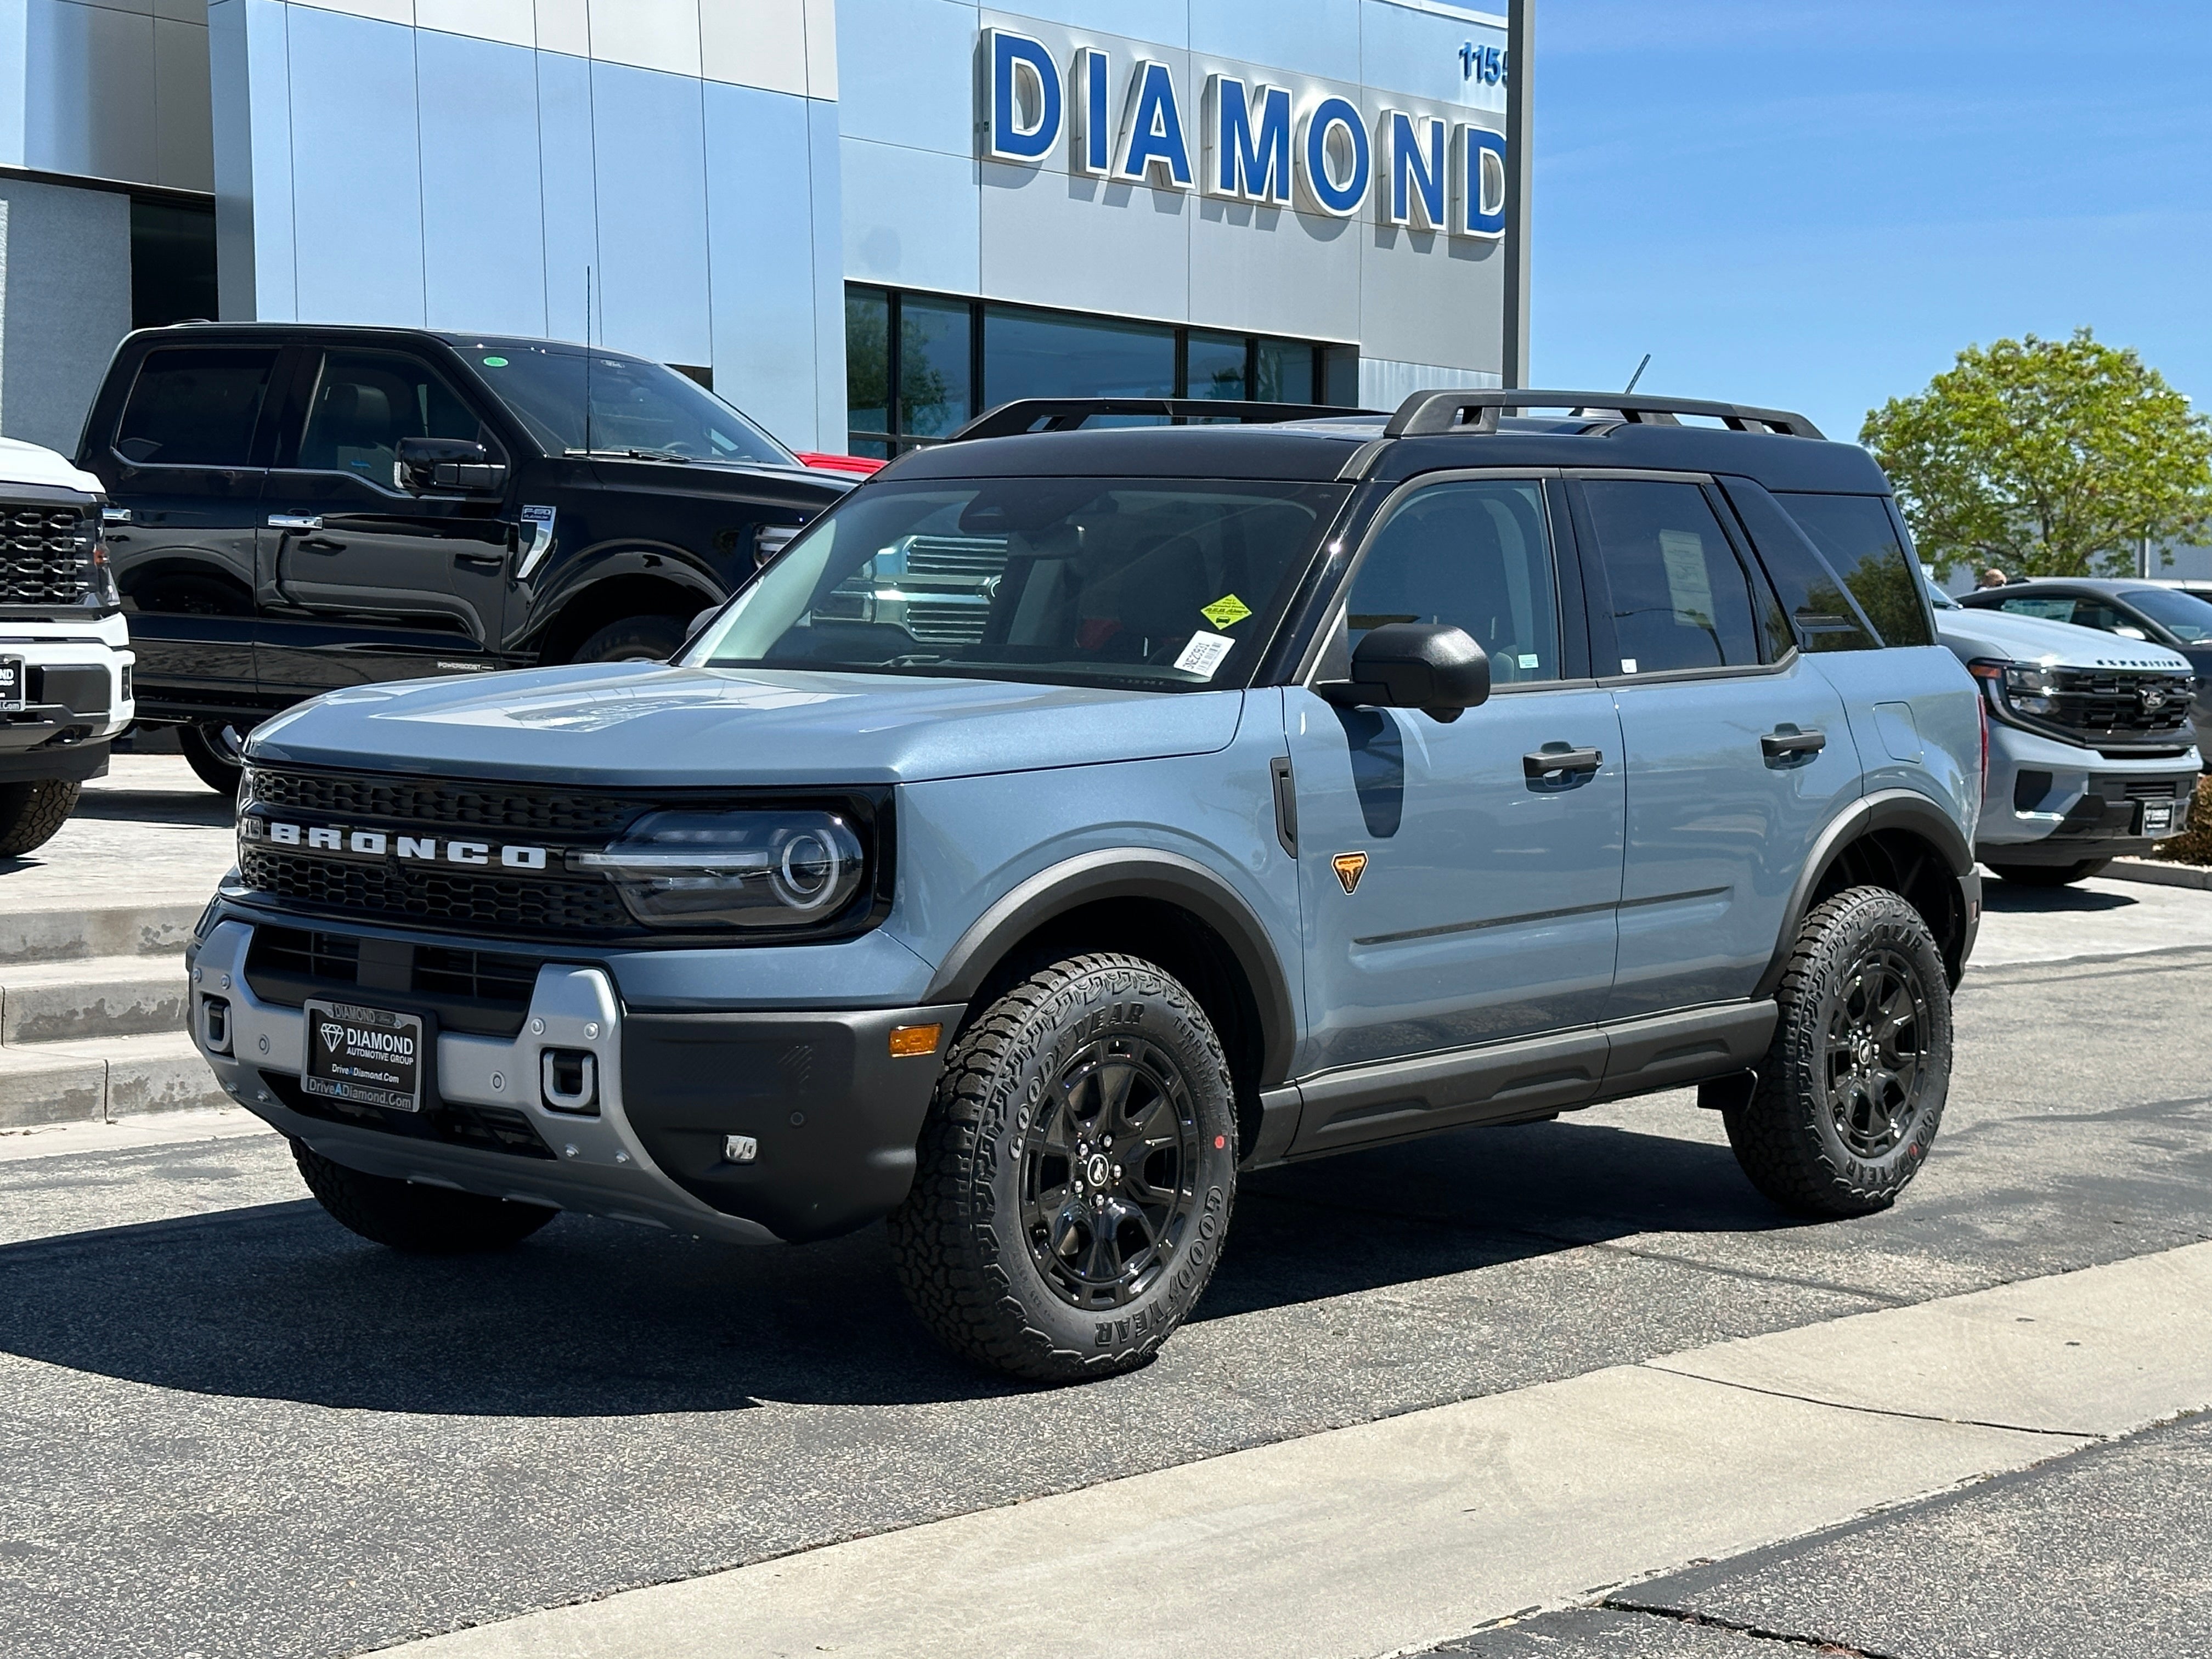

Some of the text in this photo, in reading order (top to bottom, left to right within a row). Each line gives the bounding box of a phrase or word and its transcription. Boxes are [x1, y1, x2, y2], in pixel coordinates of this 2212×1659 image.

[982, 27, 1506, 239] DIAMOND
[271, 822, 546, 869] BRONCO
[334, 1005, 376, 1023] DIAMOND
[347, 1028, 413, 1054] DIAMOND
[347, 1046, 414, 1065] AUTOMOTIVE GROUP
[332, 1064, 399, 1084] DriveADiamond.Com
[309, 1079, 411, 1109] DriveADiamond.Com
